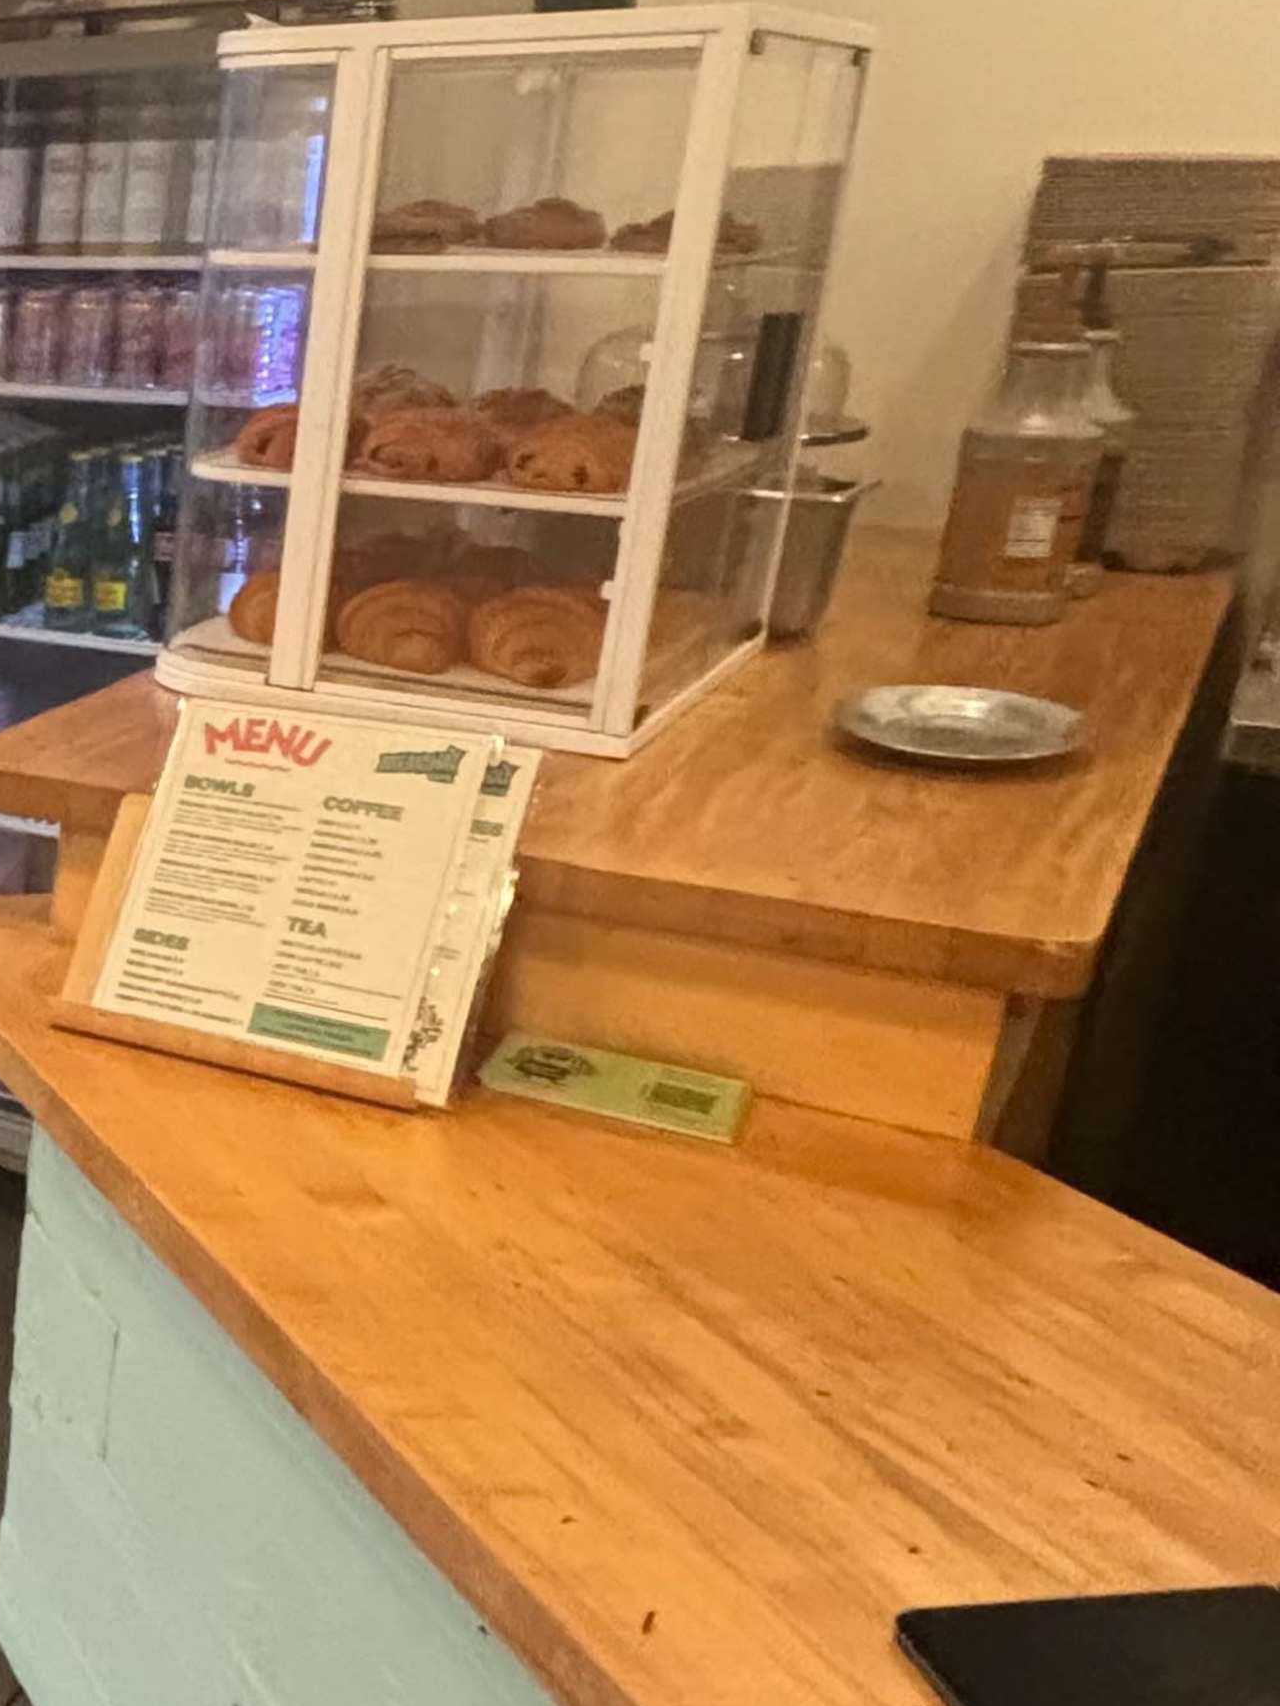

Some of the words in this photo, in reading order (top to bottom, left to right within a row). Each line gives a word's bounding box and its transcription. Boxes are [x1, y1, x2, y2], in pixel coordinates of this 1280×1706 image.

[204, 717, 333, 767] MENU
[183, 773, 256, 798] BOWLS
[322, 795, 405, 823] COFFEE
[286, 914, 327, 939] TEA
